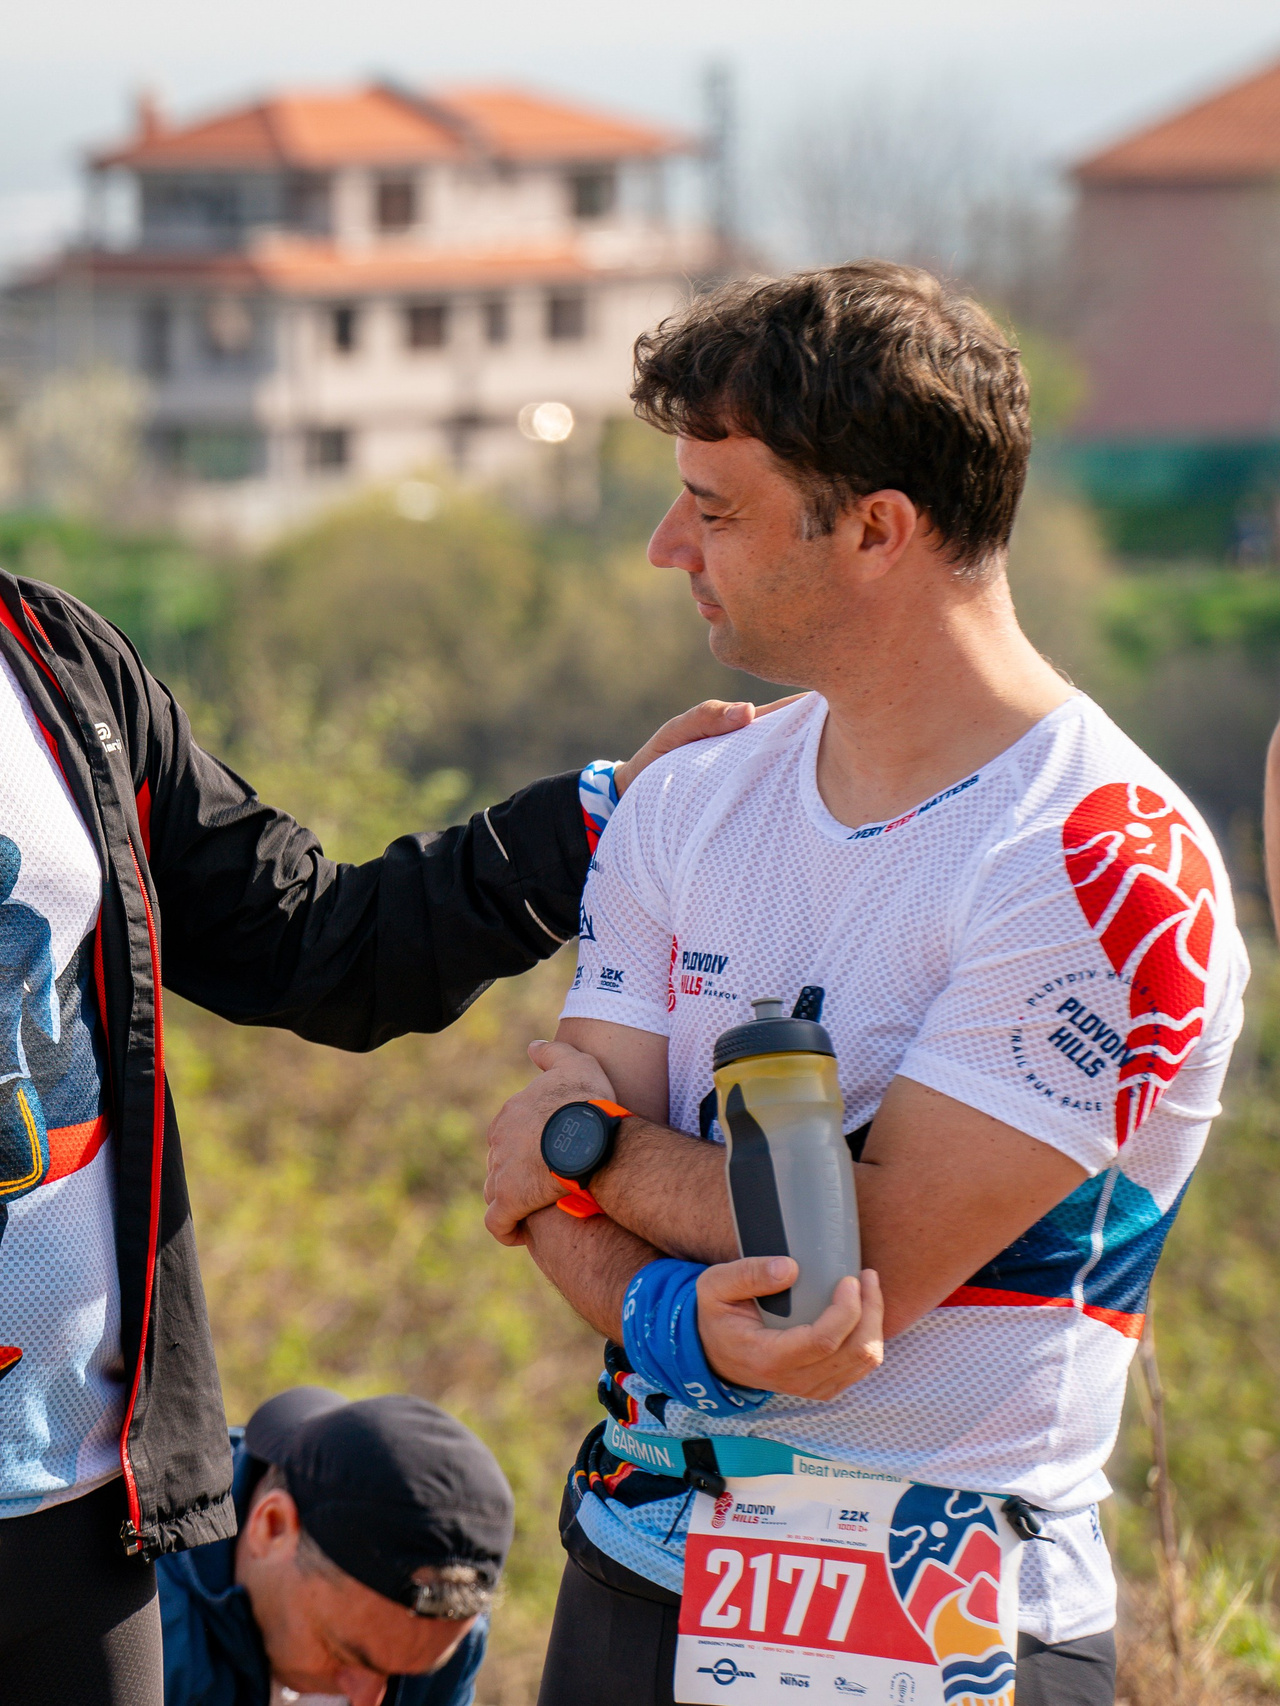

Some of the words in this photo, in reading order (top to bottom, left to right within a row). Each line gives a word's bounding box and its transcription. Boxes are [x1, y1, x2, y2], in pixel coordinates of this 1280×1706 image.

[884, 810, 918, 833] STEP
[916, 774, 980, 816] MATTERS
[682, 951, 729, 974] PLOVDIV
[1026, 969, 1098, 1007] PLOVDIV
[1107, 971, 1150, 996] HILLS
[1048, 1025, 1106, 1079] HILLS
[1056, 996, 1139, 1068] PLOVDIV
[1010, 1027, 1027, 1068] TRAIL
[1026, 1073, 1055, 1098] RUN
[1061, 1096, 1103, 1112] RACE
[611, 1424, 672, 1468] GARMIN
[800, 1459, 829, 1475] beat
[731, 1514, 759, 1524] HILLS
[735, 1503, 776, 1516] PLOVDIV
[839, 1509, 870, 1523] 22K
[700, 1548, 867, 1642] 2177
